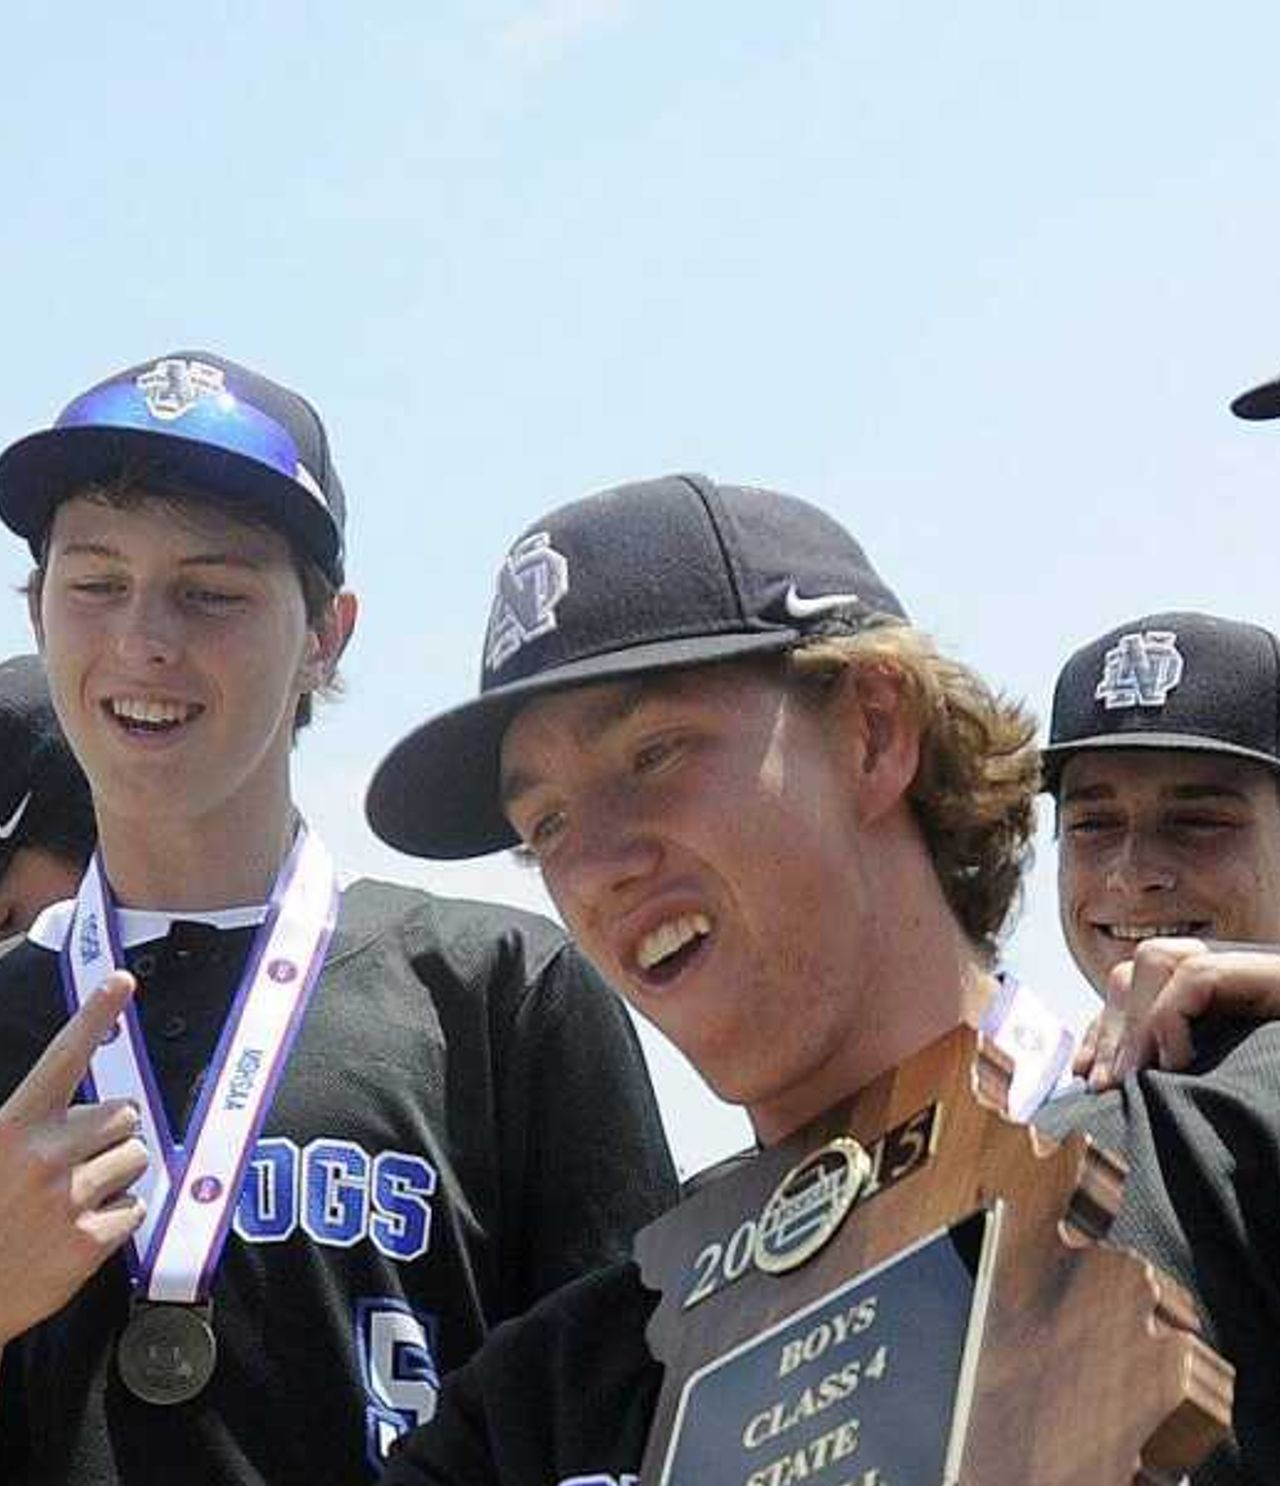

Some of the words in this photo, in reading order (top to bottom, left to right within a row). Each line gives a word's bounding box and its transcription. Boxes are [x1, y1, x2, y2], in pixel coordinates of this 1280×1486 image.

[779, 1296, 878, 1378] BOYS
[742, 1362, 861, 1448] CLASS
[866, 1345, 888, 1379] 4
